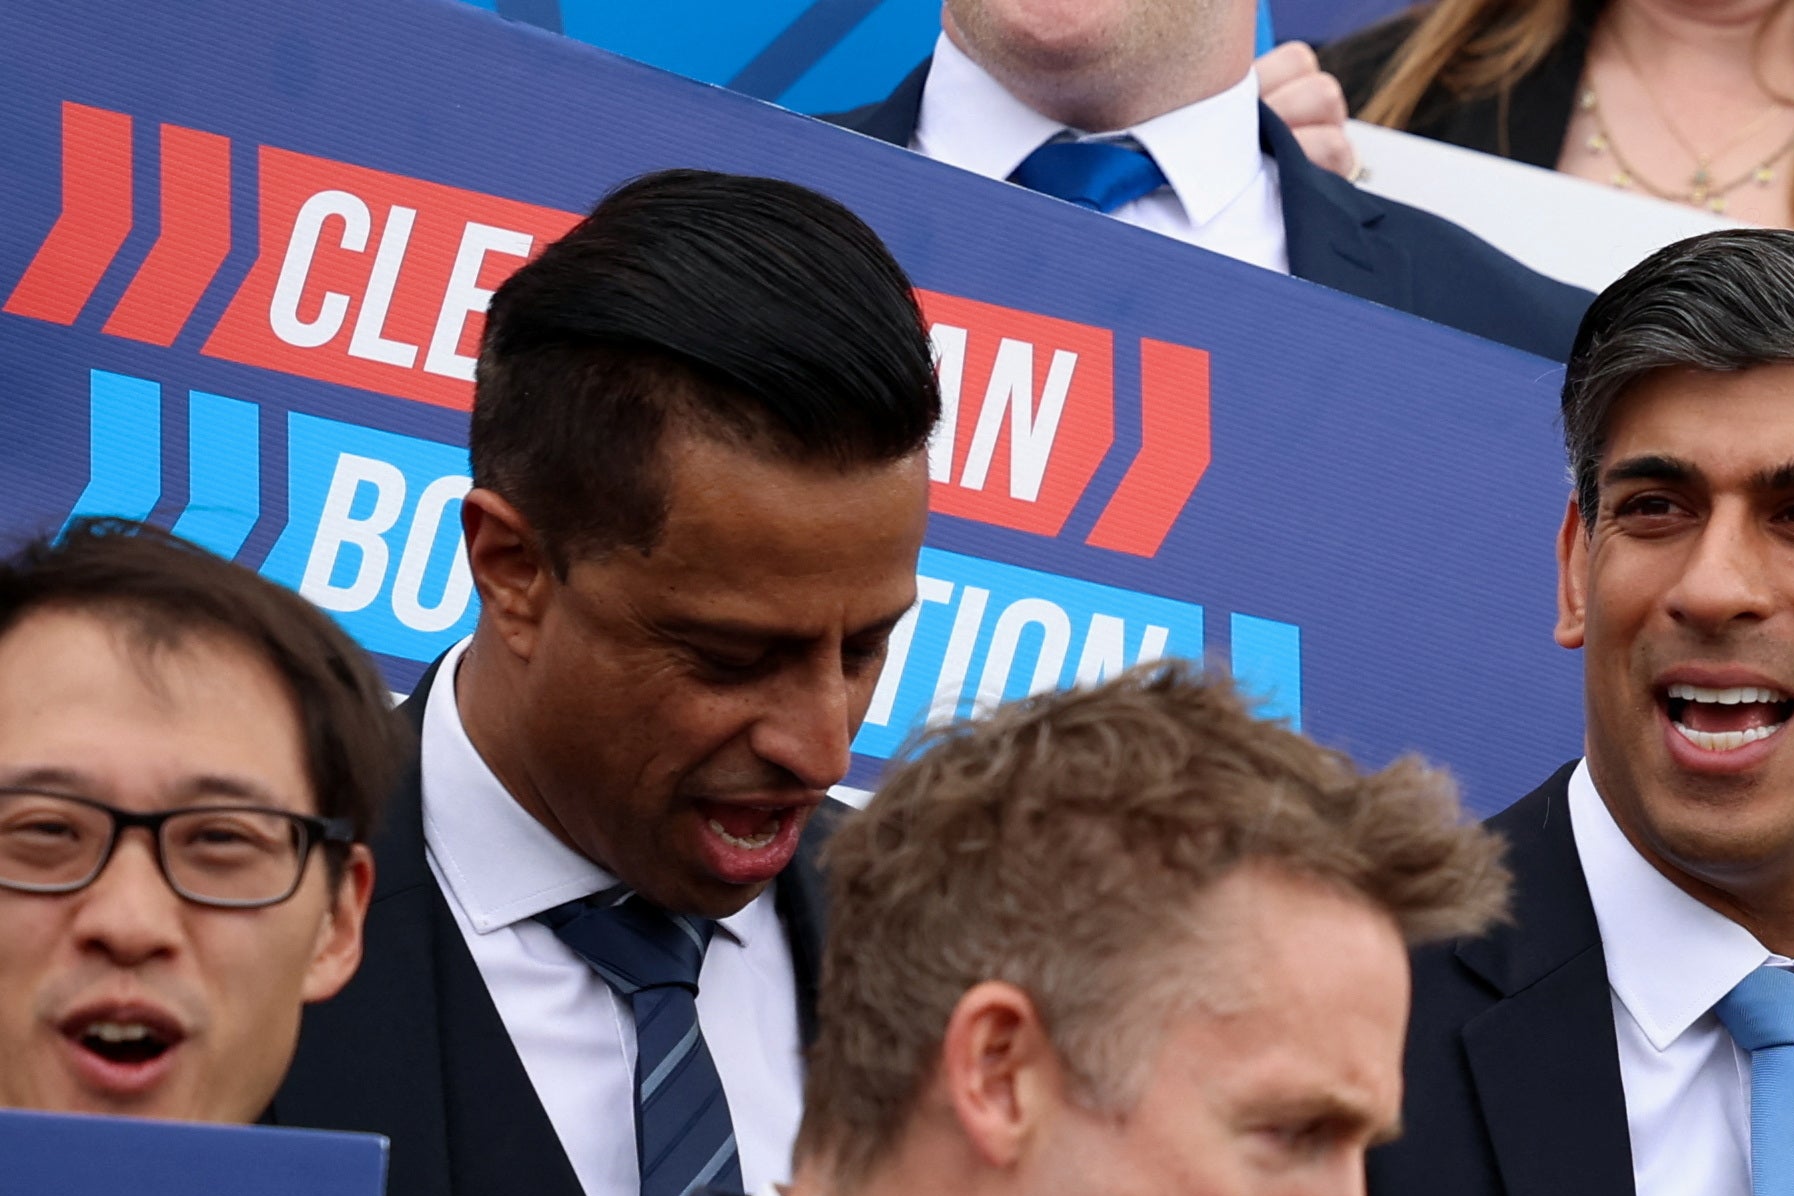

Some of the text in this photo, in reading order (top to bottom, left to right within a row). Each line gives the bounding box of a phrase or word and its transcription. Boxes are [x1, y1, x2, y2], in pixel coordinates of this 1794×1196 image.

[269, 189, 1079, 503] CLE AN
[299, 451, 1170, 735] BO TIO
